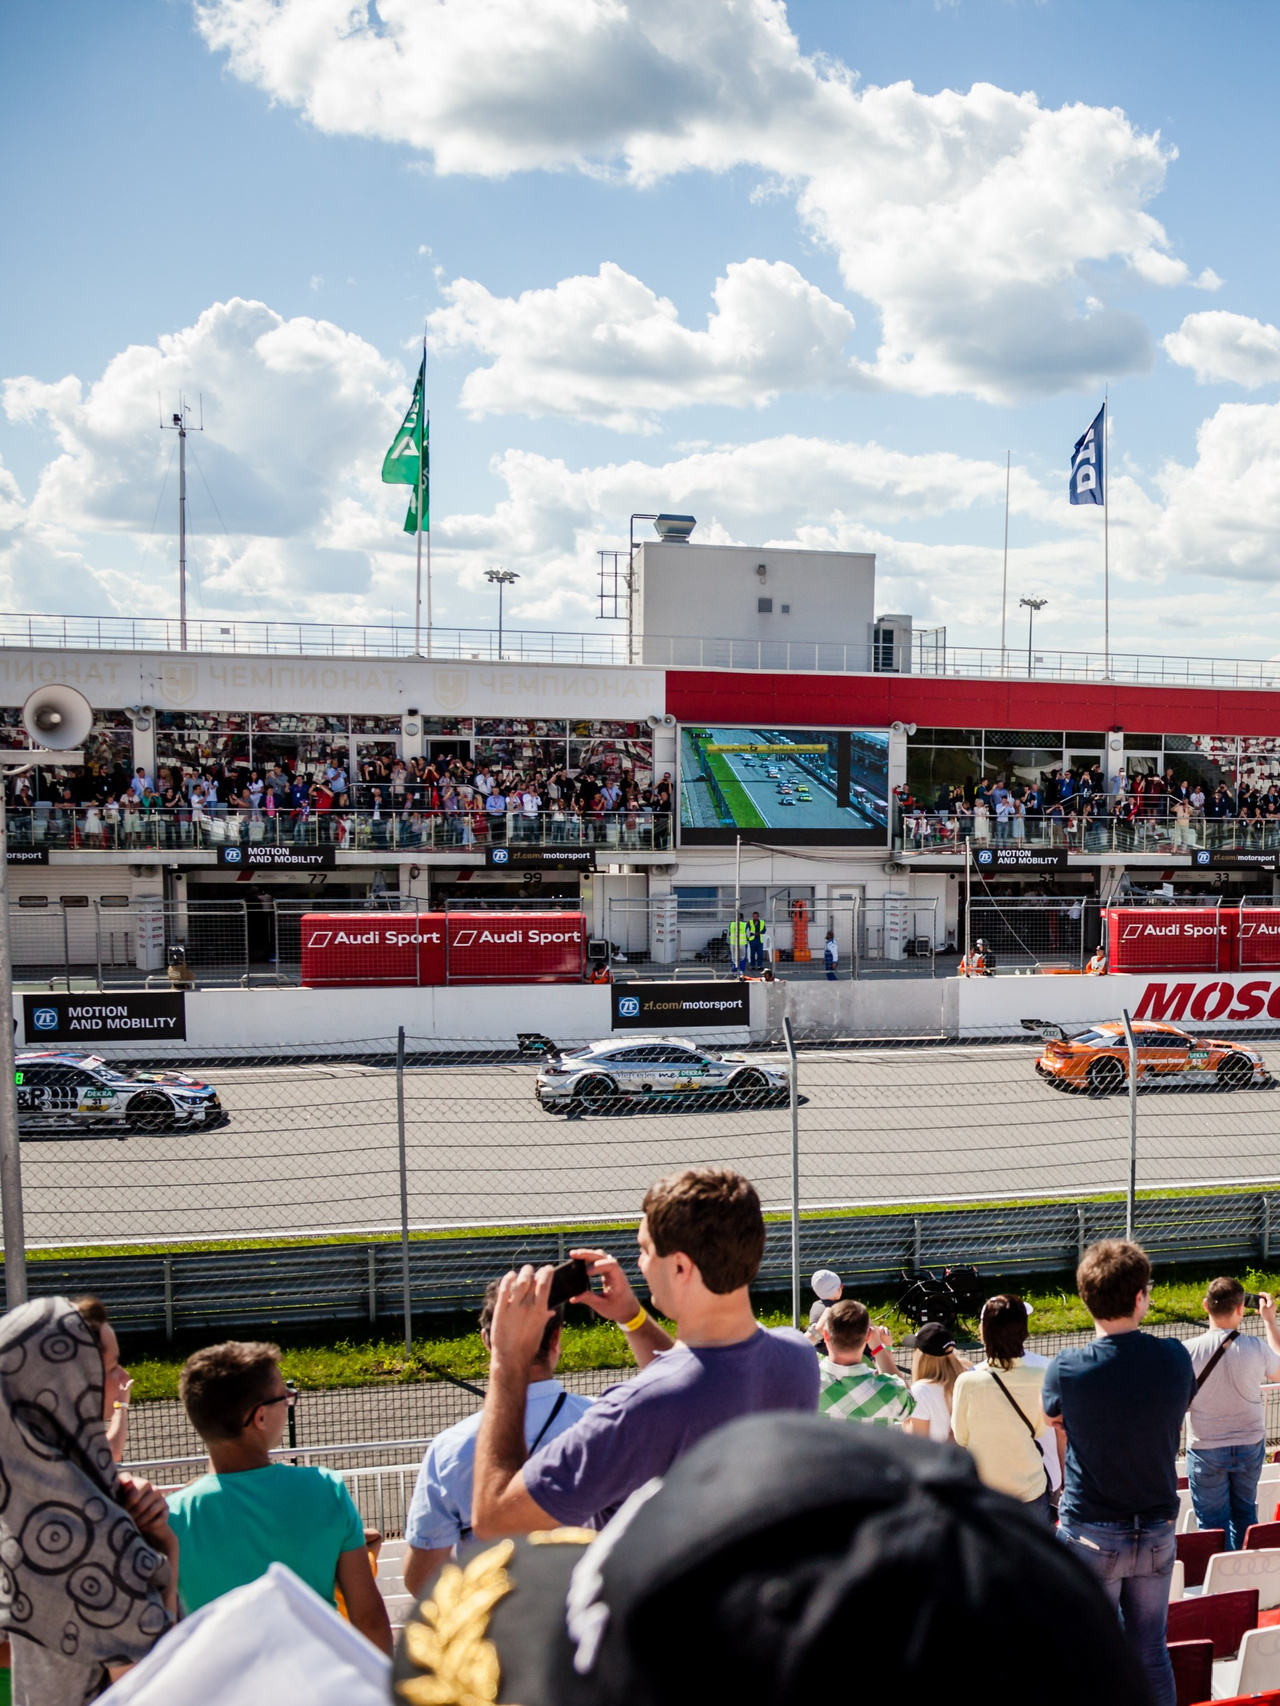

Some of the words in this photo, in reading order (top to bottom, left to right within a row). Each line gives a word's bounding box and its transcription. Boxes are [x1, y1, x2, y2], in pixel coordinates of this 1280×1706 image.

[210, 666, 398, 691] ЧЕМПИОНАТ
[478, 673, 655, 698] ЧЕМПИОНАТ
[7, 852, 42, 860] orsport
[513, 852, 590, 860] zf.com/motorsport
[1214, 854, 1275, 862] zf.com/motorsport
[308, 874, 328, 884] 77
[523, 873, 542, 883] 99
[1214, 873, 1229, 882] 33
[1144, 924, 1180, 936] Audi
[1184, 924, 1227, 938] Sport
[334, 932, 380, 944] Audi
[385, 932, 440, 946] Sport
[479, 930, 519, 943] Audi
[528, 930, 580, 946] Sport
[644, 1000, 743, 1010] zf.com/motorsport
[68, 1006, 128, 1017] MOTION
[70, 1020, 102, 1030] AND
[107, 1017, 176, 1029] MOBILITY
